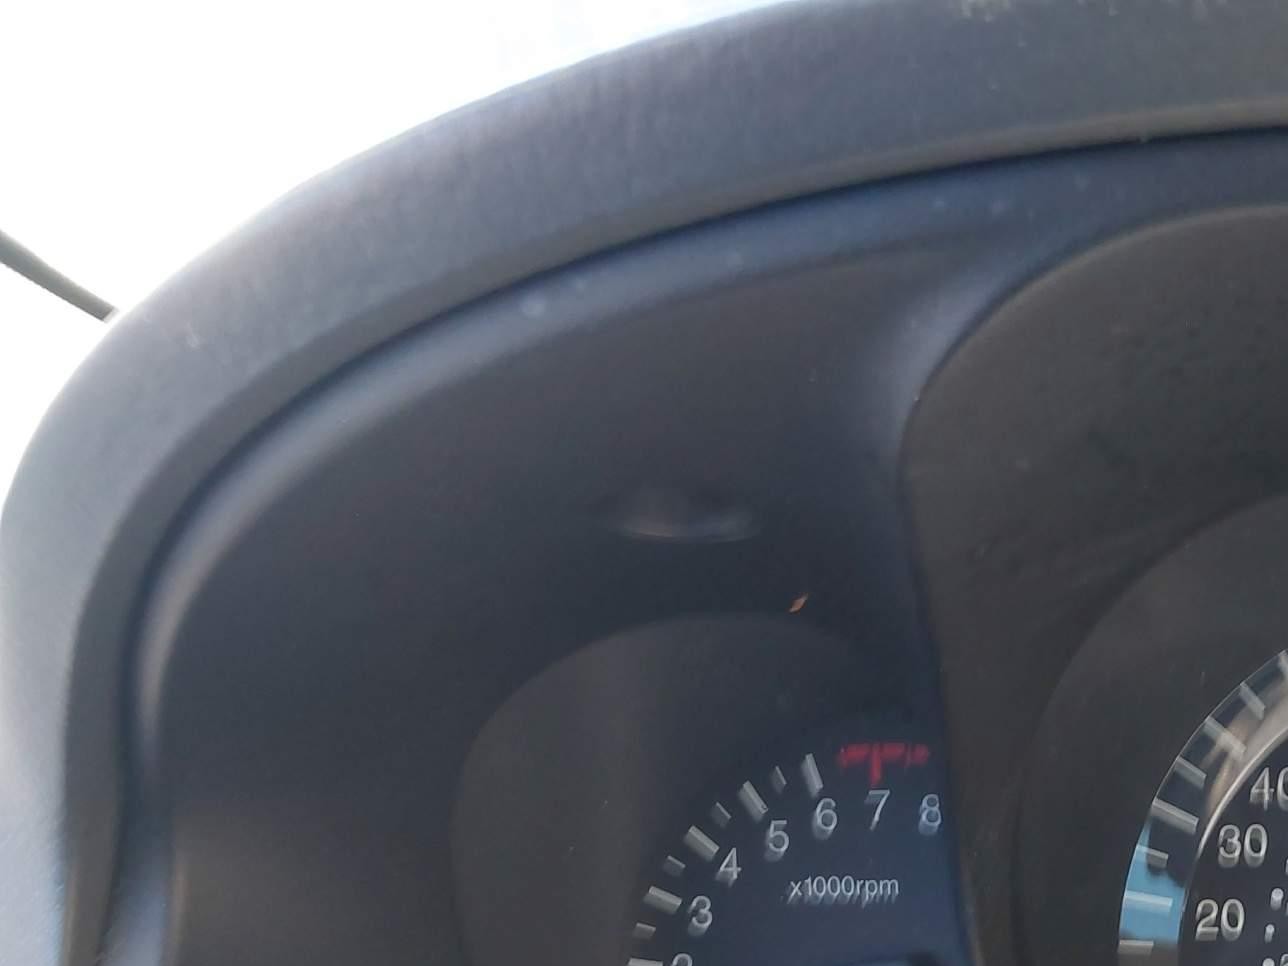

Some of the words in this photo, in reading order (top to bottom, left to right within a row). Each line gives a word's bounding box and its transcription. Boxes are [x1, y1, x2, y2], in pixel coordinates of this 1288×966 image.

[812, 798, 837, 838] 6
[865, 790, 889, 830] 7
[919, 794, 942, 833] 8
[766, 820, 790, 860] 5
[1217, 824, 1267, 865] 30
[717, 848, 741, 885] 4
[789, 875, 900, 906] x1000rpm
[689, 896, 713, 934] 3
[1195, 899, 1245, 940] 20
